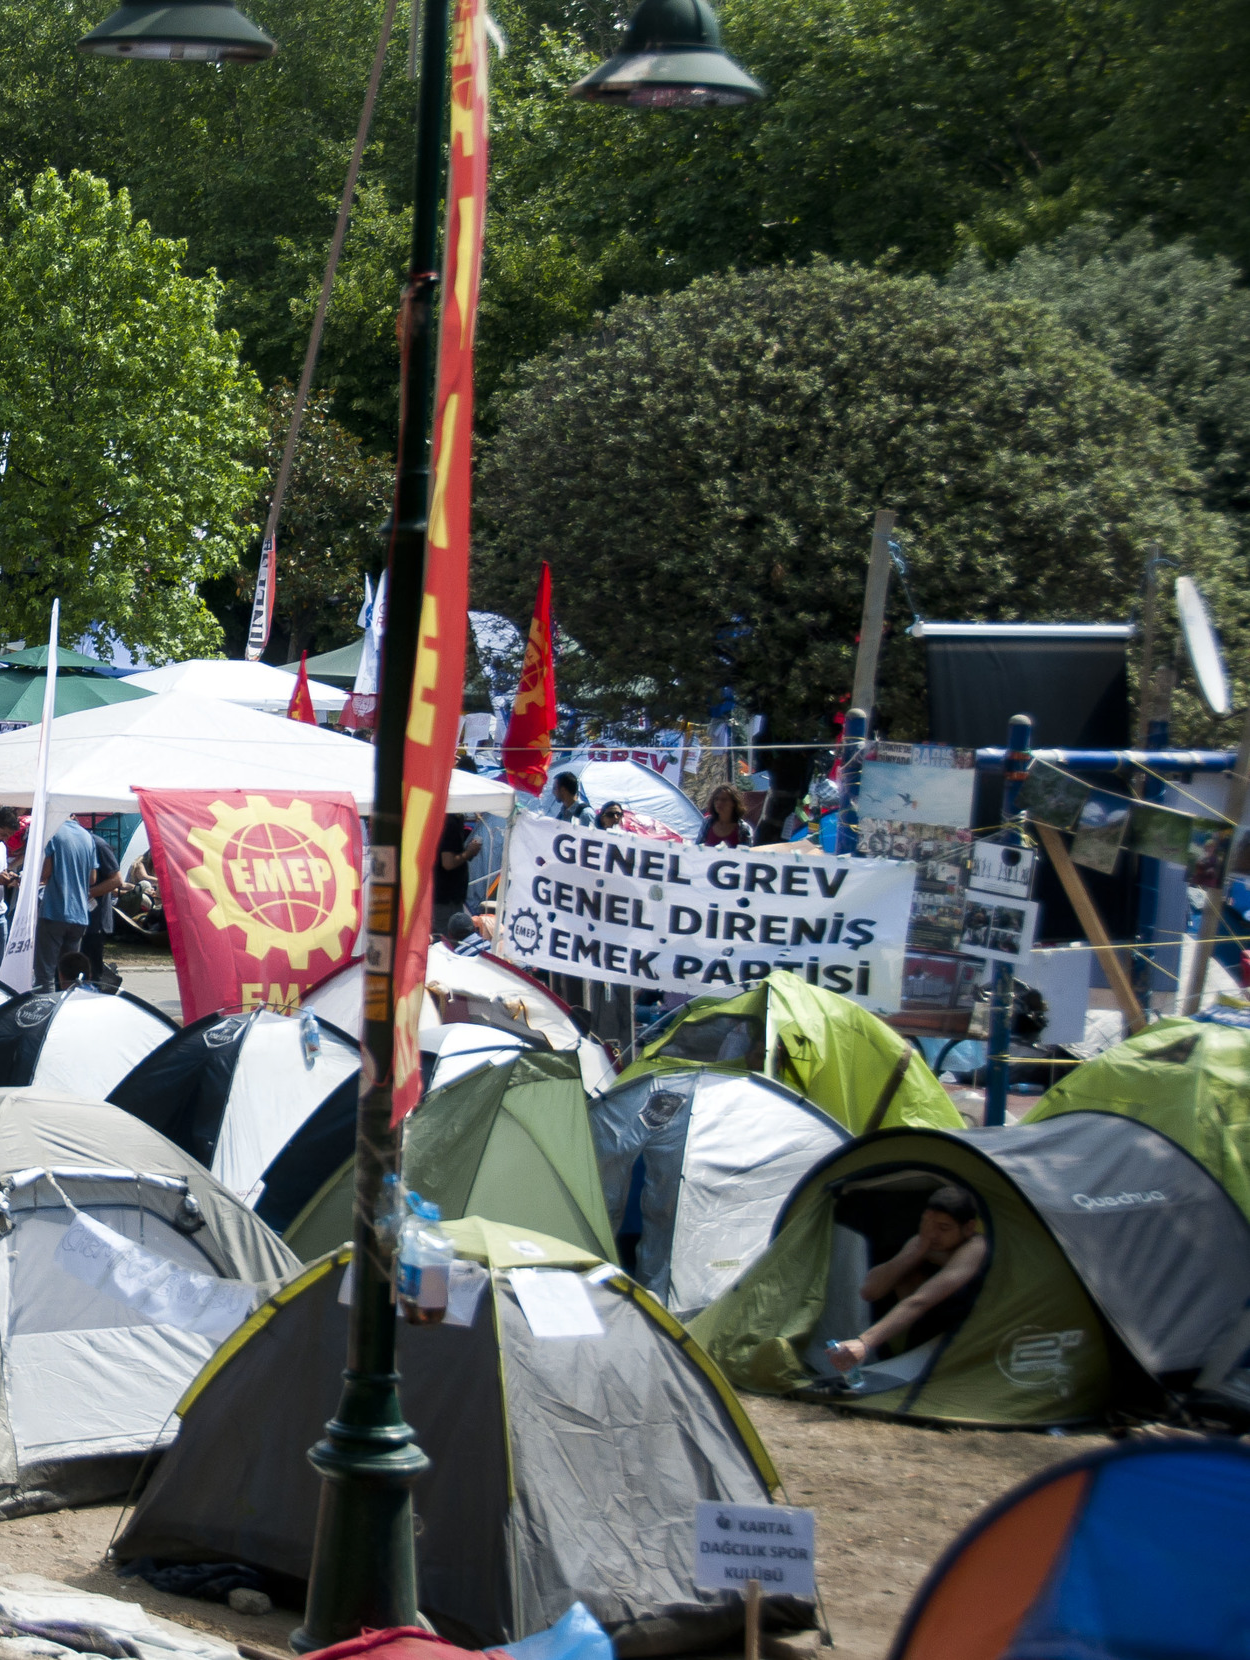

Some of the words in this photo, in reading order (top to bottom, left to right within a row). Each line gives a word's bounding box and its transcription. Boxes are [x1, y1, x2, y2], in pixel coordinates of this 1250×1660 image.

[227, 857, 333, 893] EMEP
[552, 833, 691, 886] GENEL
[706, 859, 849, 900] GREV
[531, 875, 654, 931] GENEL
[668, 902, 878, 951] DİRENİŞ
[514, 923, 536, 940] EMEP
[548, 926, 662, 981] EMEK
[738, 1520, 794, 1536] KARTAL
[700, 1540, 767, 1557] DAĞCILIK
[770, 1547, 809, 1561] SPOR
[724, 1565, 785, 1583] KULÜBÜ
